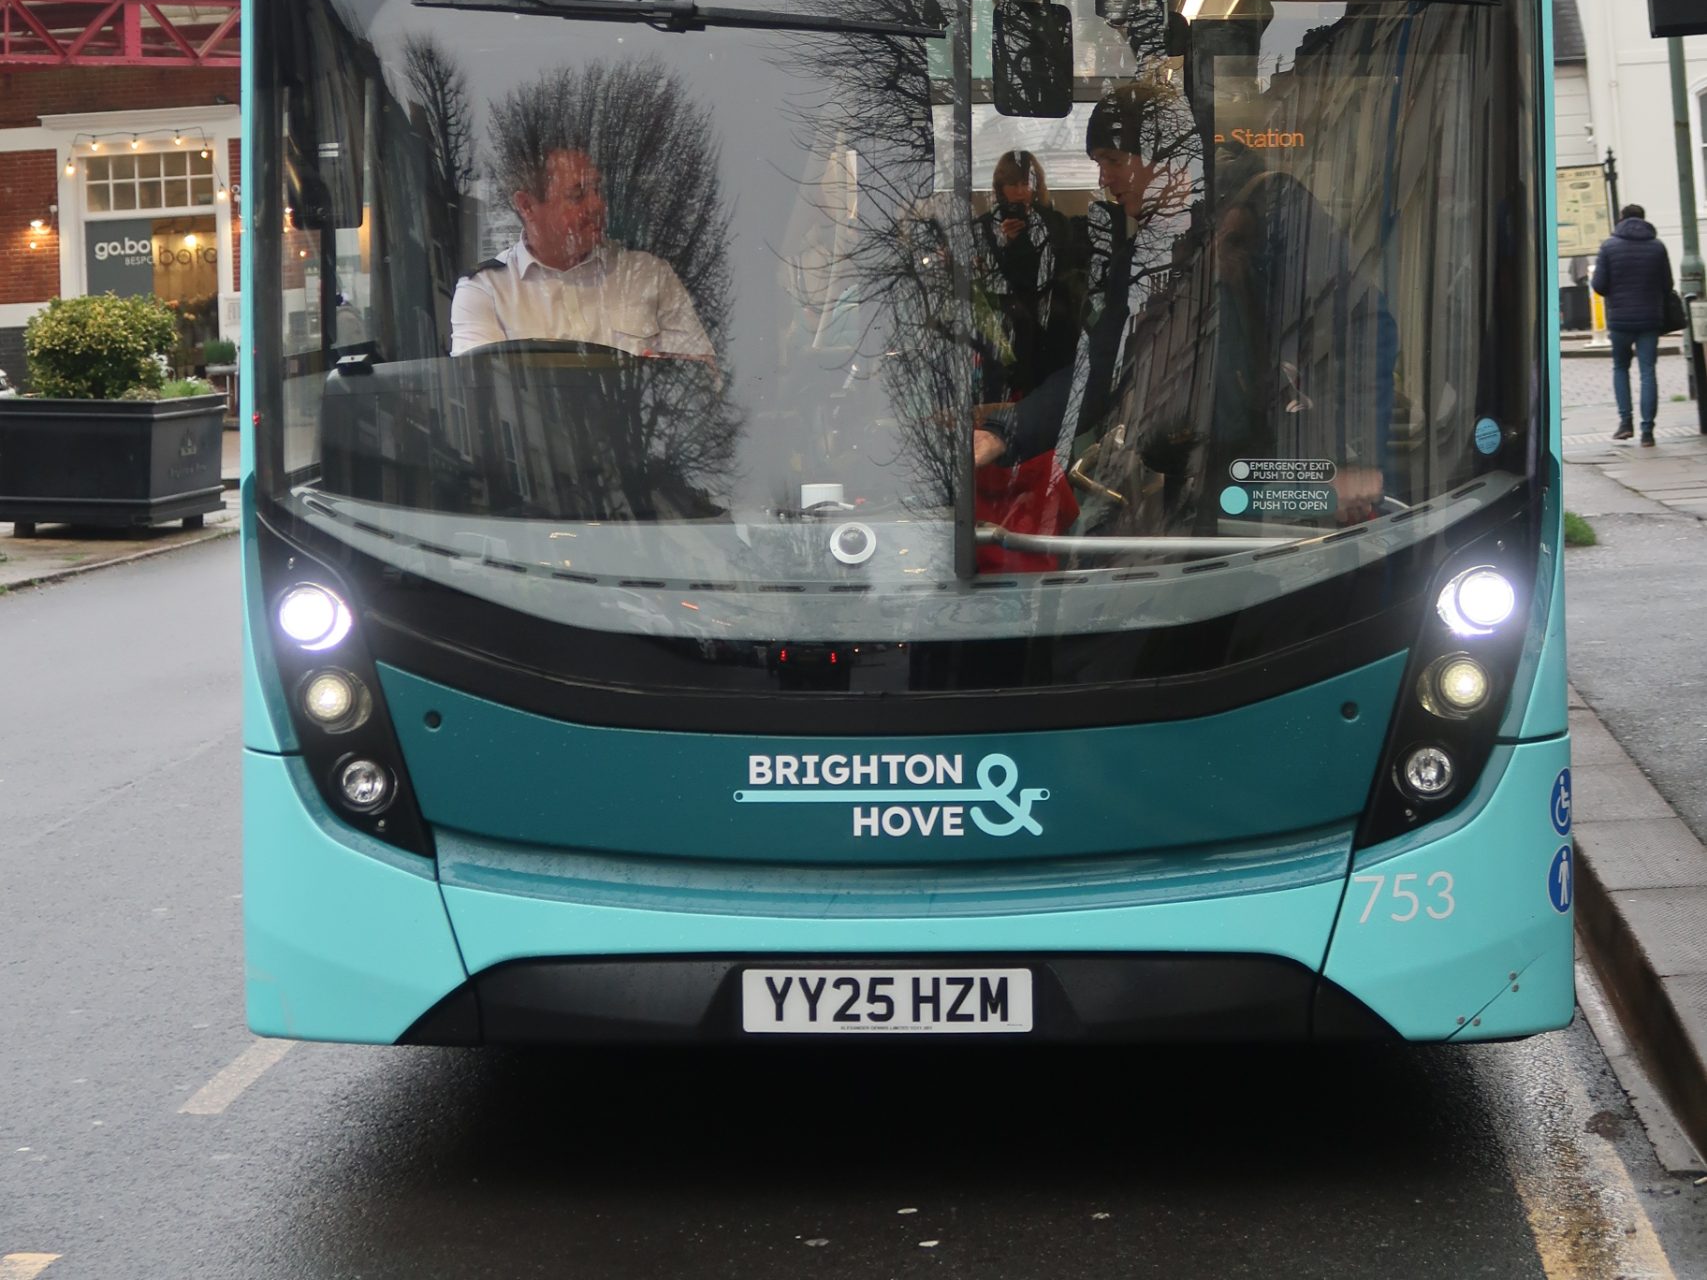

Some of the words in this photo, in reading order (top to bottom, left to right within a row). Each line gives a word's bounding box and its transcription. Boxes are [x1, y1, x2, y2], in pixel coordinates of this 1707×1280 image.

[1231, 128, 1304, 147] Station
[1250, 462, 1307, 470] EMERGENCY
[1253, 471, 1278, 479] PUSH
[1281, 471, 1294, 479] TO
[1253, 491, 1263, 499] IN
[1266, 491, 1329, 499] EMERGENCY
[1253, 501, 1280, 509] PUSH
[1283, 501, 1296, 510] TO
[1299, 501, 1328, 510] OPEN
[748, 754, 963, 785] BRIGHTON
[853, 807, 964, 836] HOVE
[1354, 871, 1455, 923] 753
[765, 976, 895, 1022] YY25
[912, 976, 1009, 1022] HZM
